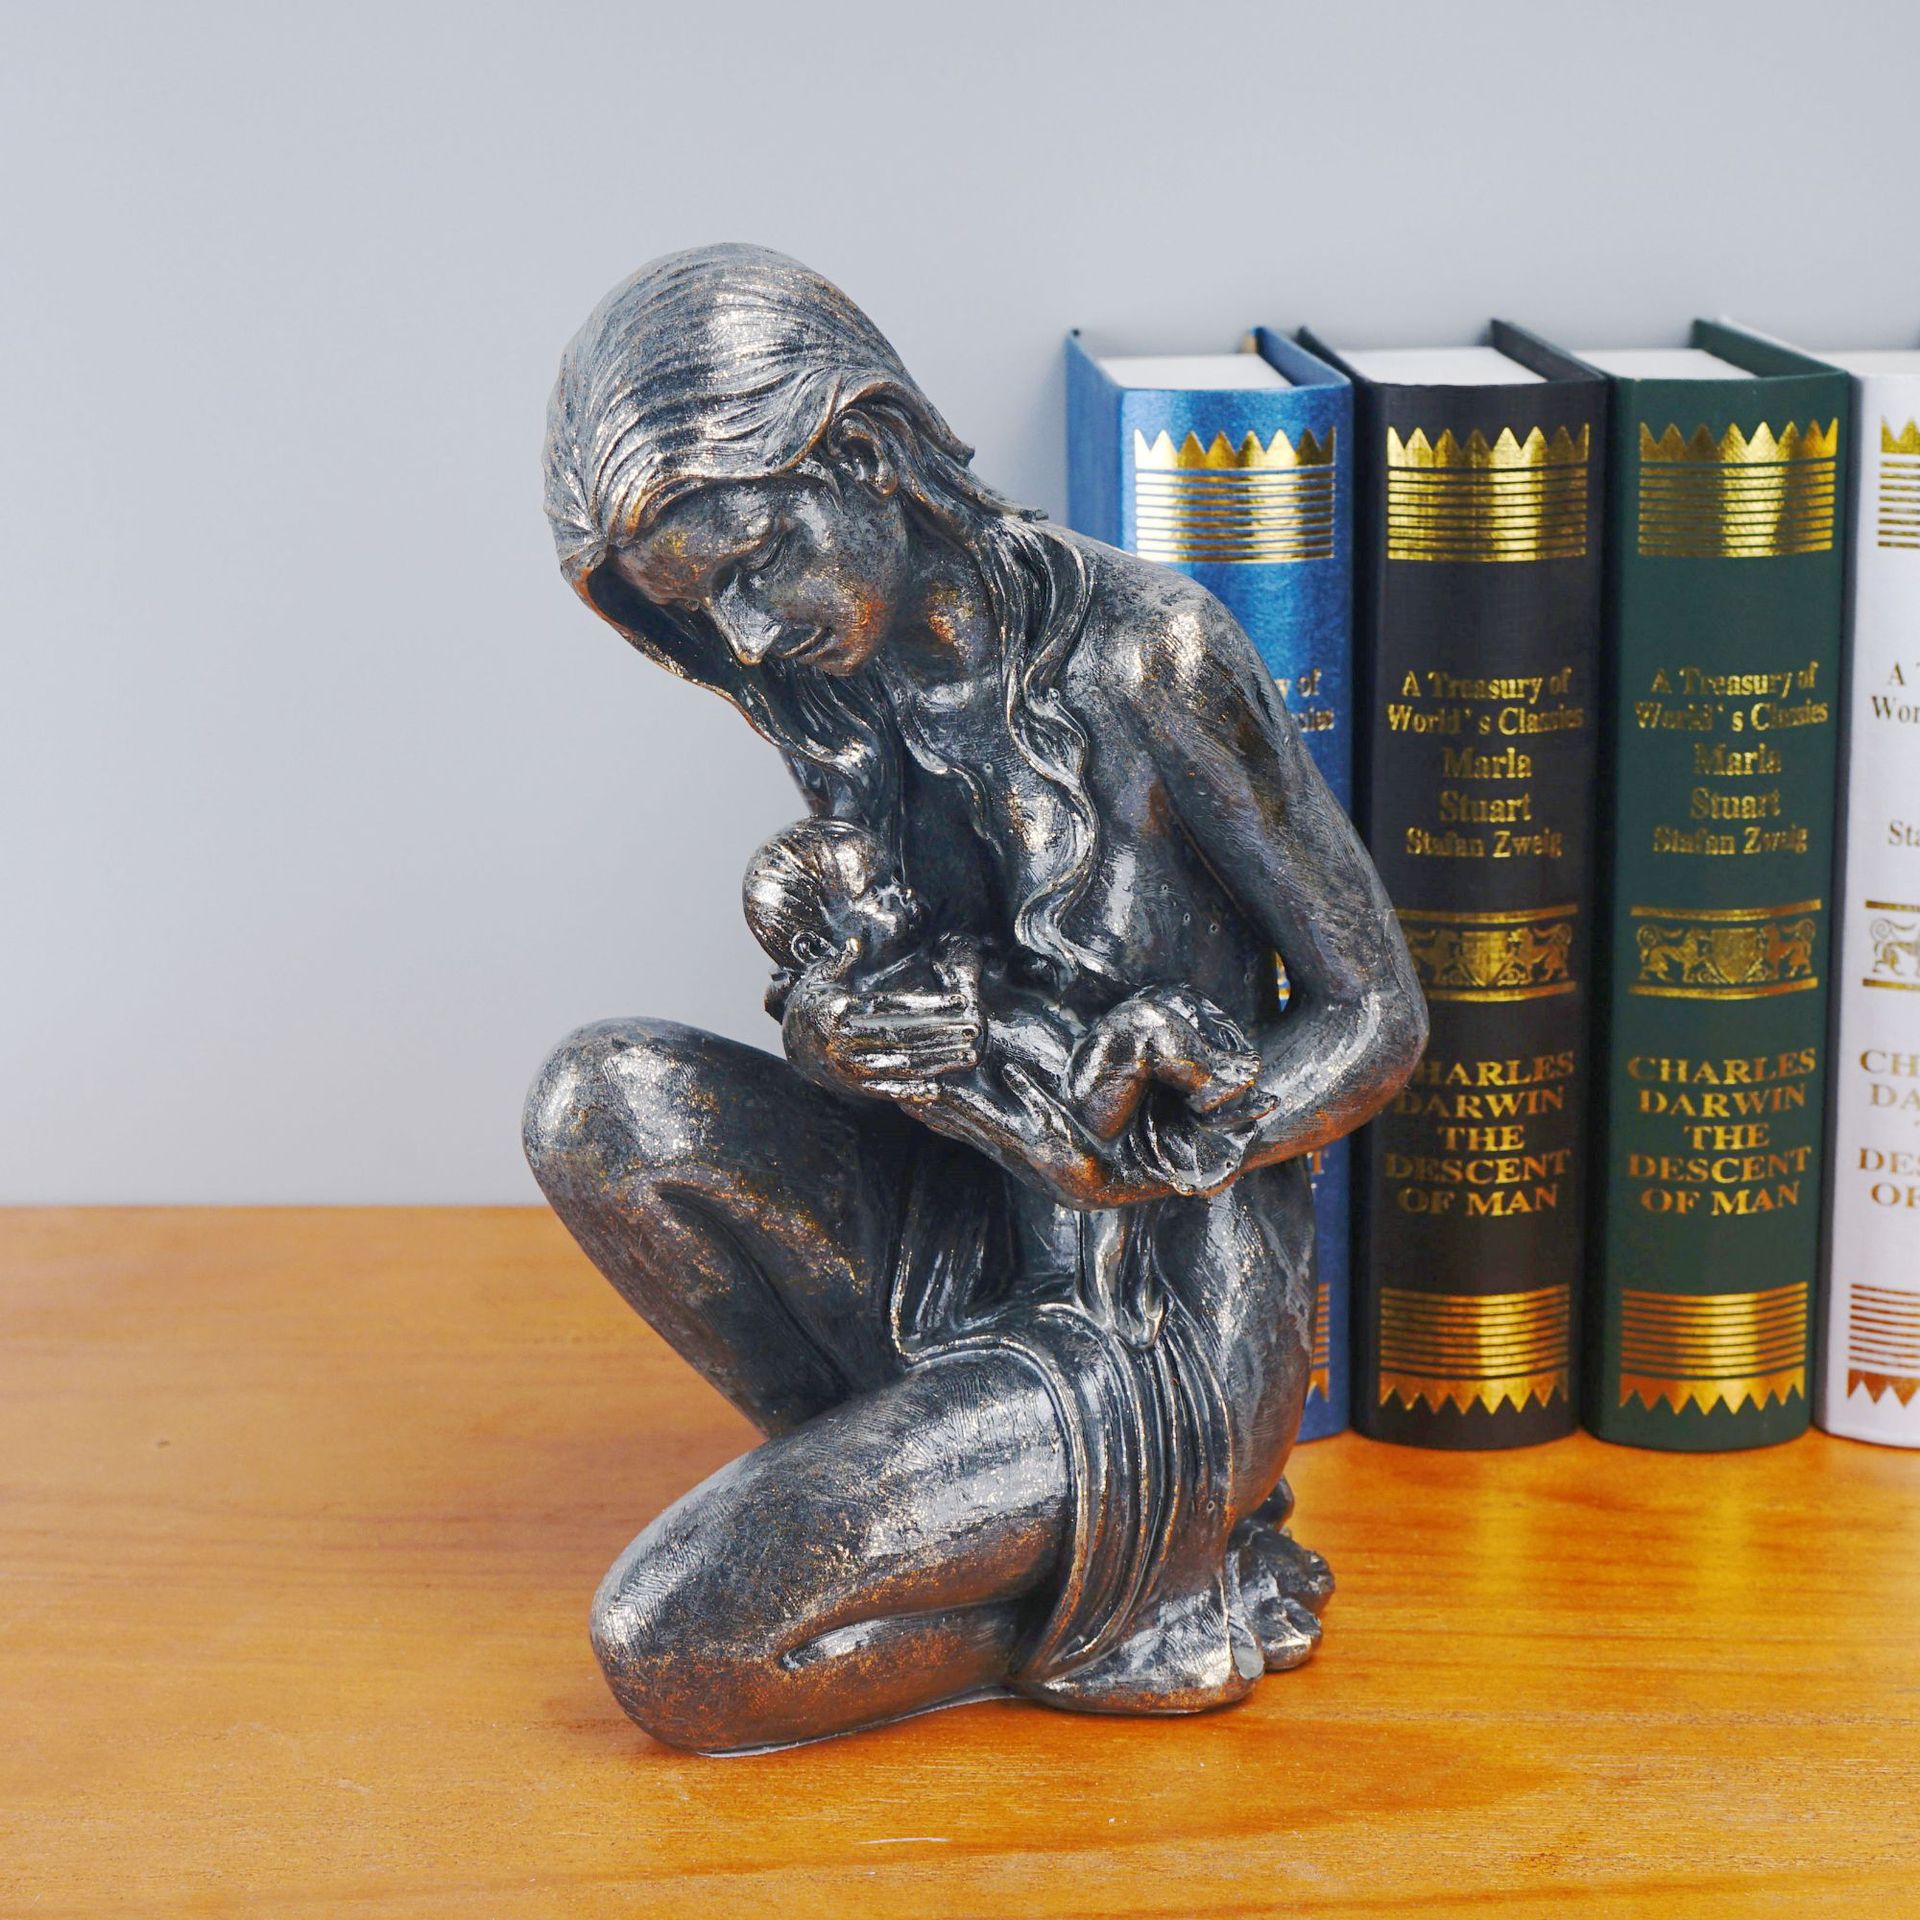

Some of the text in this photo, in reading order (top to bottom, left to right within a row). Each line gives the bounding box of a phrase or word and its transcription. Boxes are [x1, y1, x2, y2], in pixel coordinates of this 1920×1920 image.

[1402, 667, 1572, 704] A Treasury of
[1650, 661, 1818, 698] A Treasury of
[1886, 661, 1905, 687] A
[1499, 704, 1584, 735] Classics
[1751, 699, 1828, 731] Classics
[1440, 790, 1532, 822] Stuart
[1690, 786, 1780, 820] Stuart
[1493, 826, 1563, 858] Zweig
[1743, 822, 1808, 854] Zweig
[1413, 1050, 1574, 1087] HARLES
[1627, 1048, 1816, 1084] CHARLES
[1394, 1085, 1565, 1119] DARWIN
[1639, 1083, 1806, 1117] DARWIN
[1438, 1124, 1525, 1151] THE
[1684, 1123, 1770, 1150] THE
[1385, 1149, 1571, 1184] DESCENT
[1628, 1146, 1812, 1183] DESCENT
[1397, 1184, 1558, 1216] OF MAN
[1641, 1181, 1799, 1216] OF MAN
